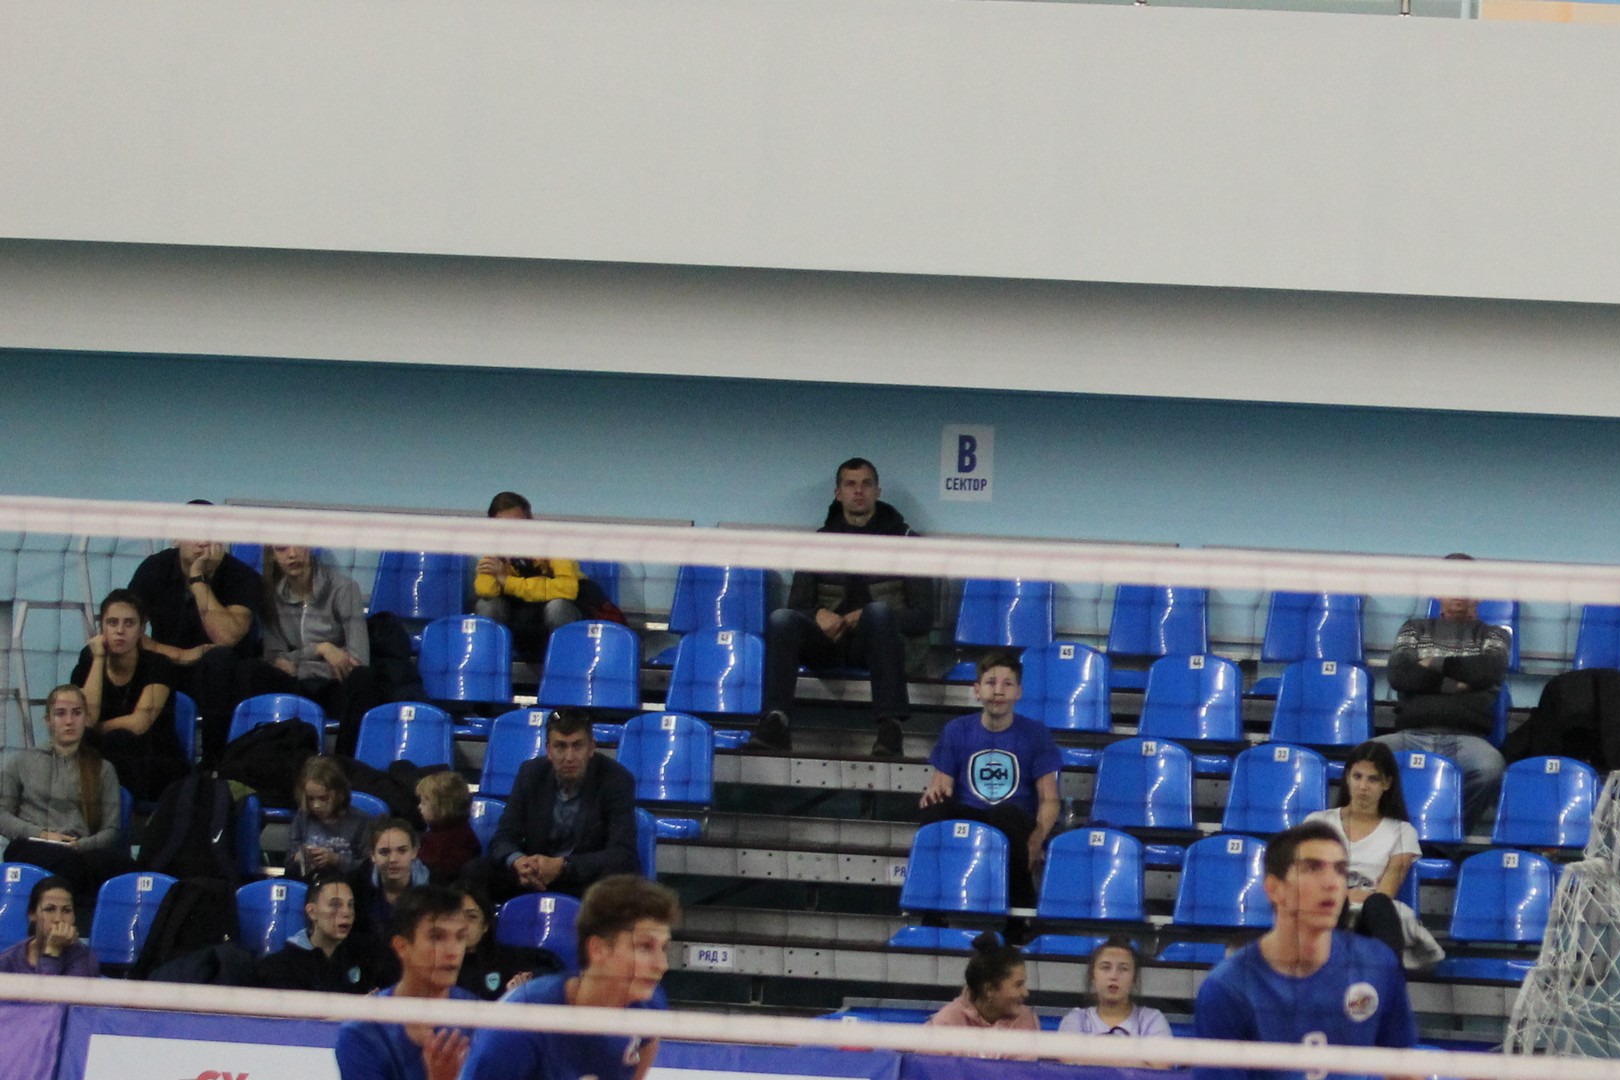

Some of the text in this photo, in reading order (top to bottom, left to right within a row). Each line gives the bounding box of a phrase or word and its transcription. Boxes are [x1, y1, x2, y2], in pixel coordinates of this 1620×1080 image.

[958, 433, 977, 473] В
[946, 477, 987, 491] СЕКТОР
[698, 950, 728, 962] РЯД 3
